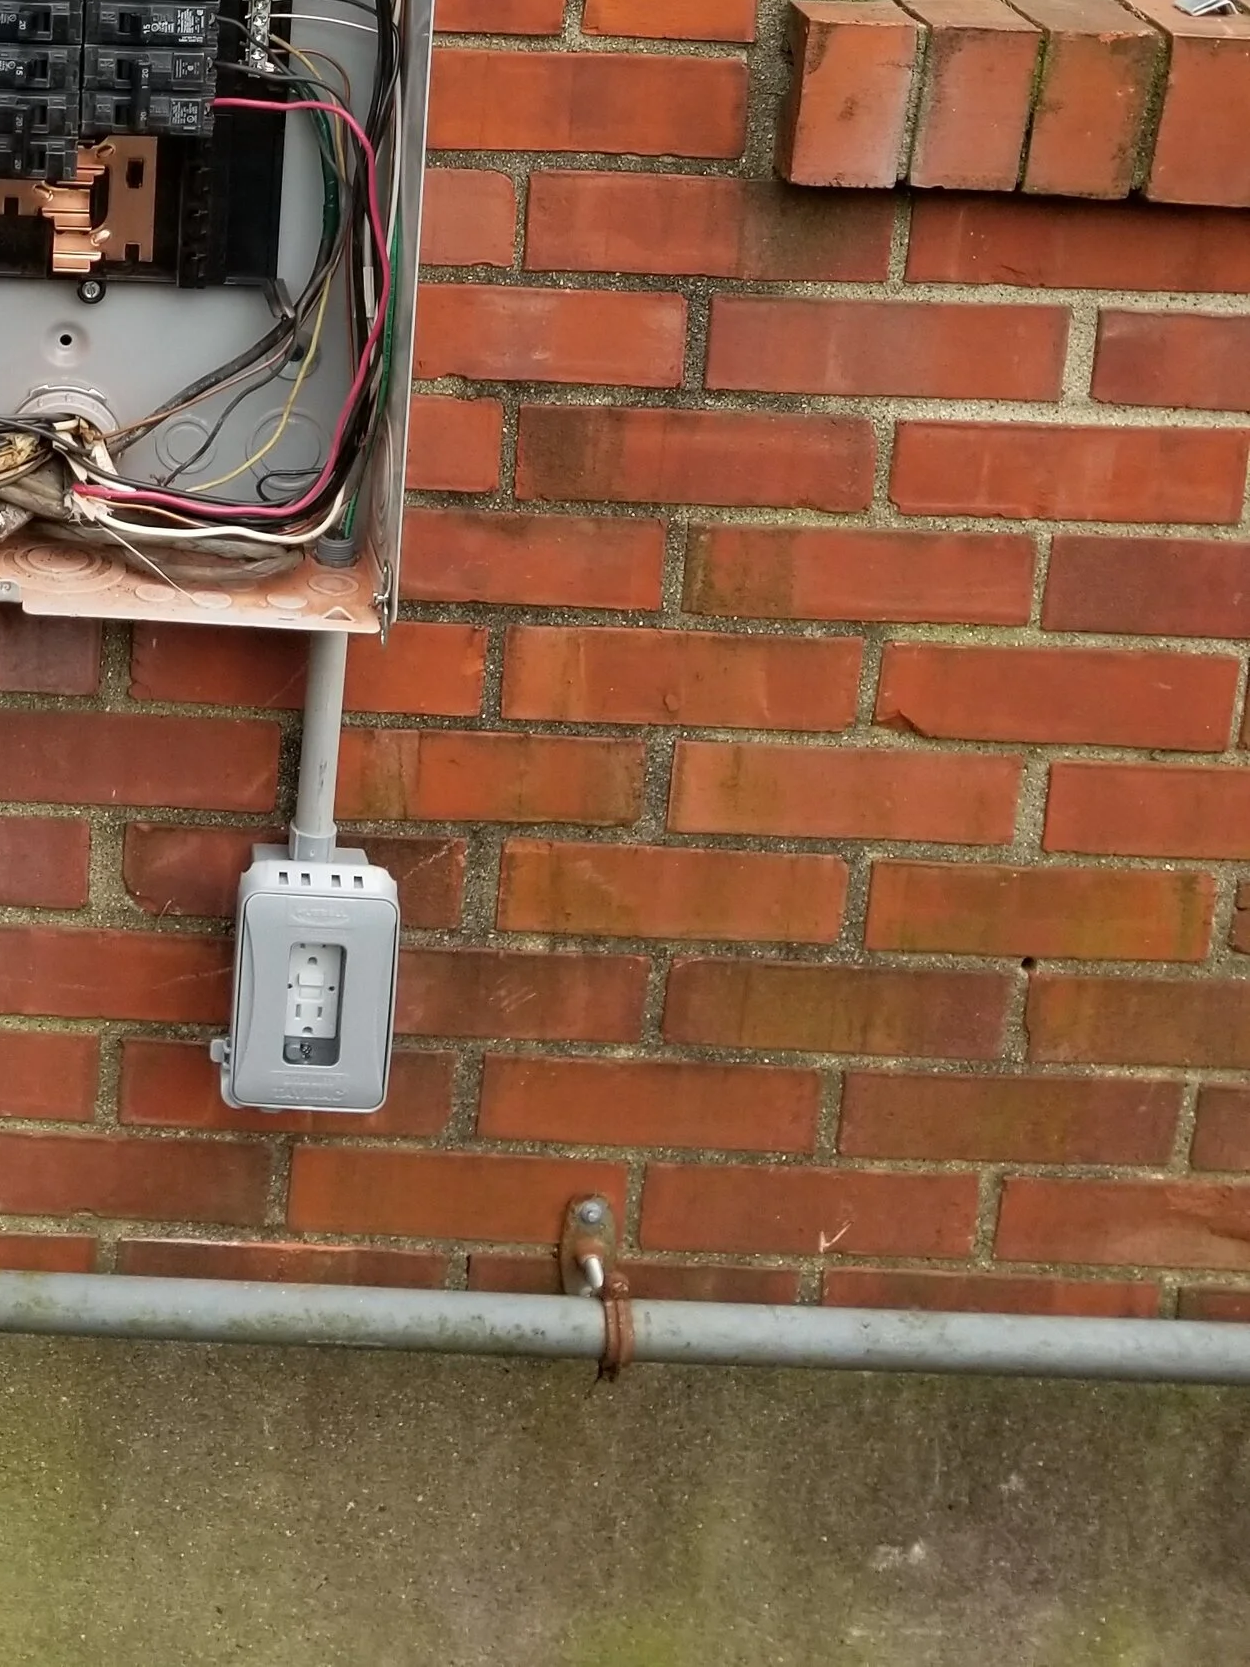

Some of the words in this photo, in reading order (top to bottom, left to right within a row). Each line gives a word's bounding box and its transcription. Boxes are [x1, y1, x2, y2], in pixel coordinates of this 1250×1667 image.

[19, 20, 26, 30] 20
[143, 24, 151, 34] 15
[16, 66, 23, 75] 15
[142, 68, 149, 78] 20
[16, 117, 23, 127] 20
[14, 159, 22, 169] 20
